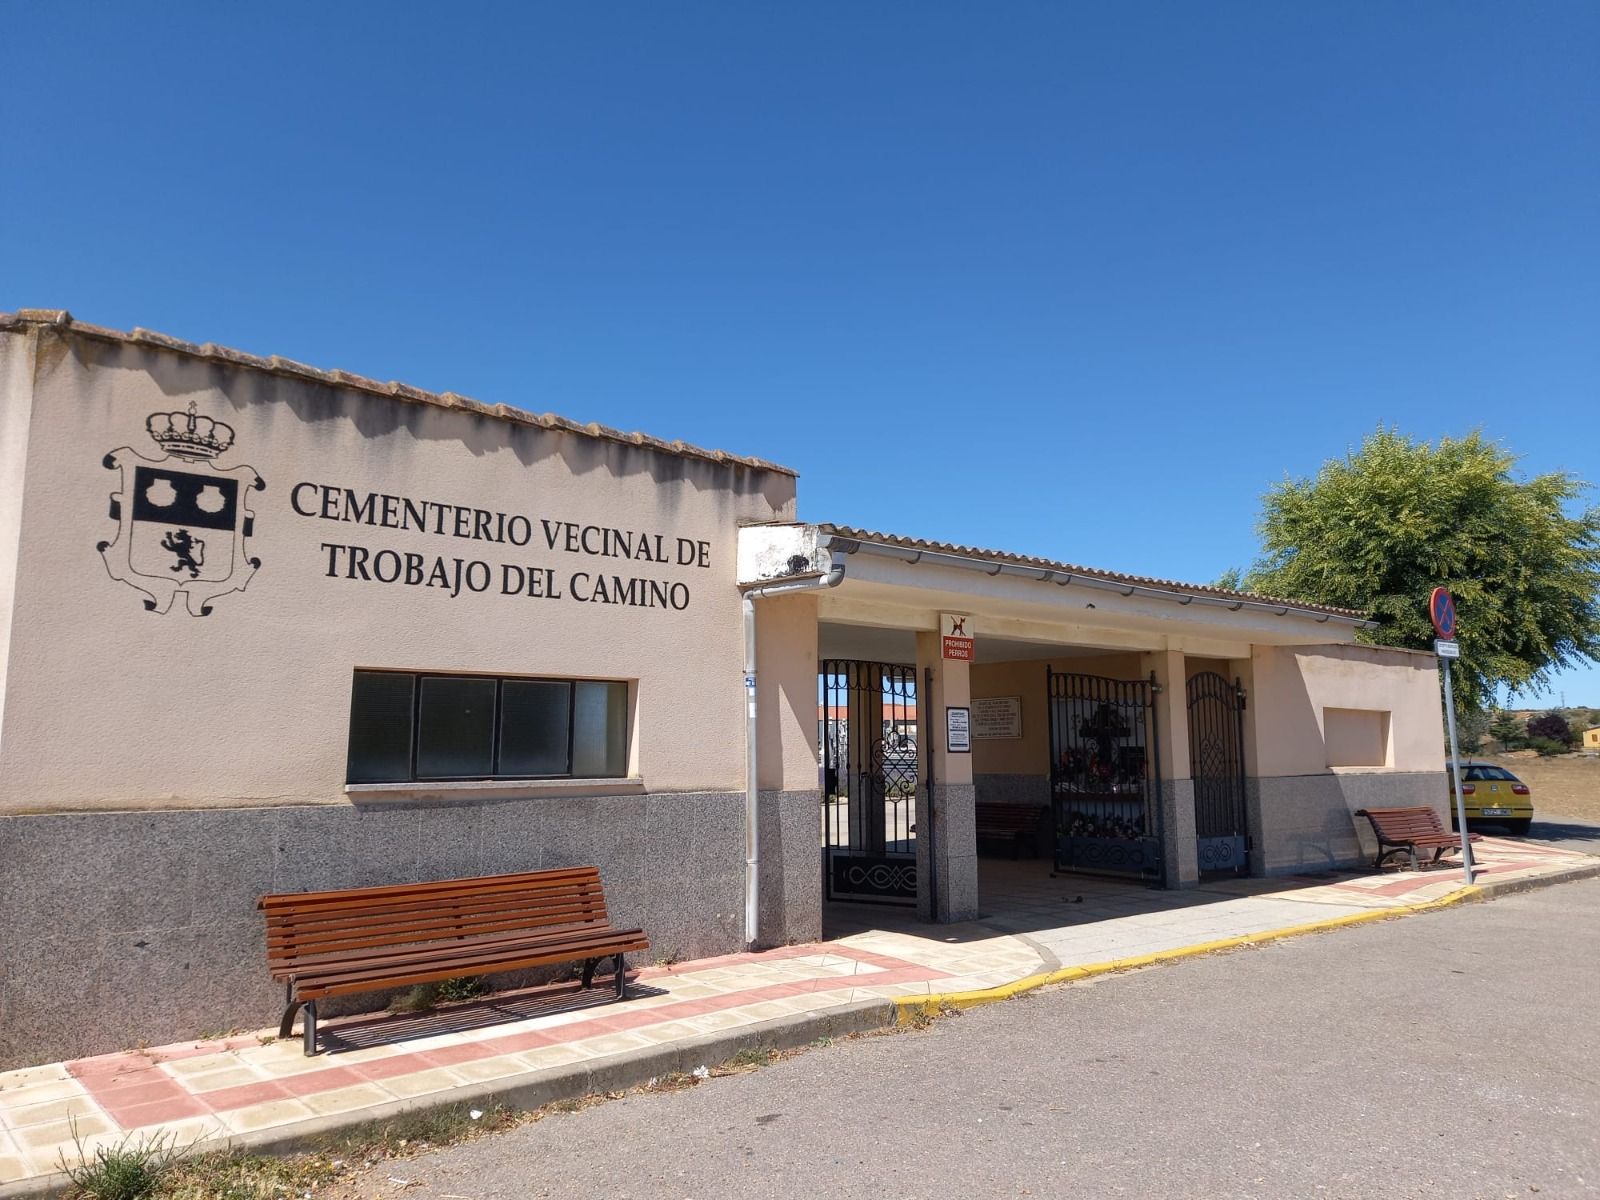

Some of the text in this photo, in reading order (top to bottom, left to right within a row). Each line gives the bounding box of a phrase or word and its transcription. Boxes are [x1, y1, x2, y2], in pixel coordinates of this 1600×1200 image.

[290, 482, 711, 568] CEMENTERIO VECINAL DE
[321, 542, 690, 610] TROBAJO DEL CAMINO
[944, 640, 972, 649] PROHIBIDO
[948, 648, 969, 658] PERROS
